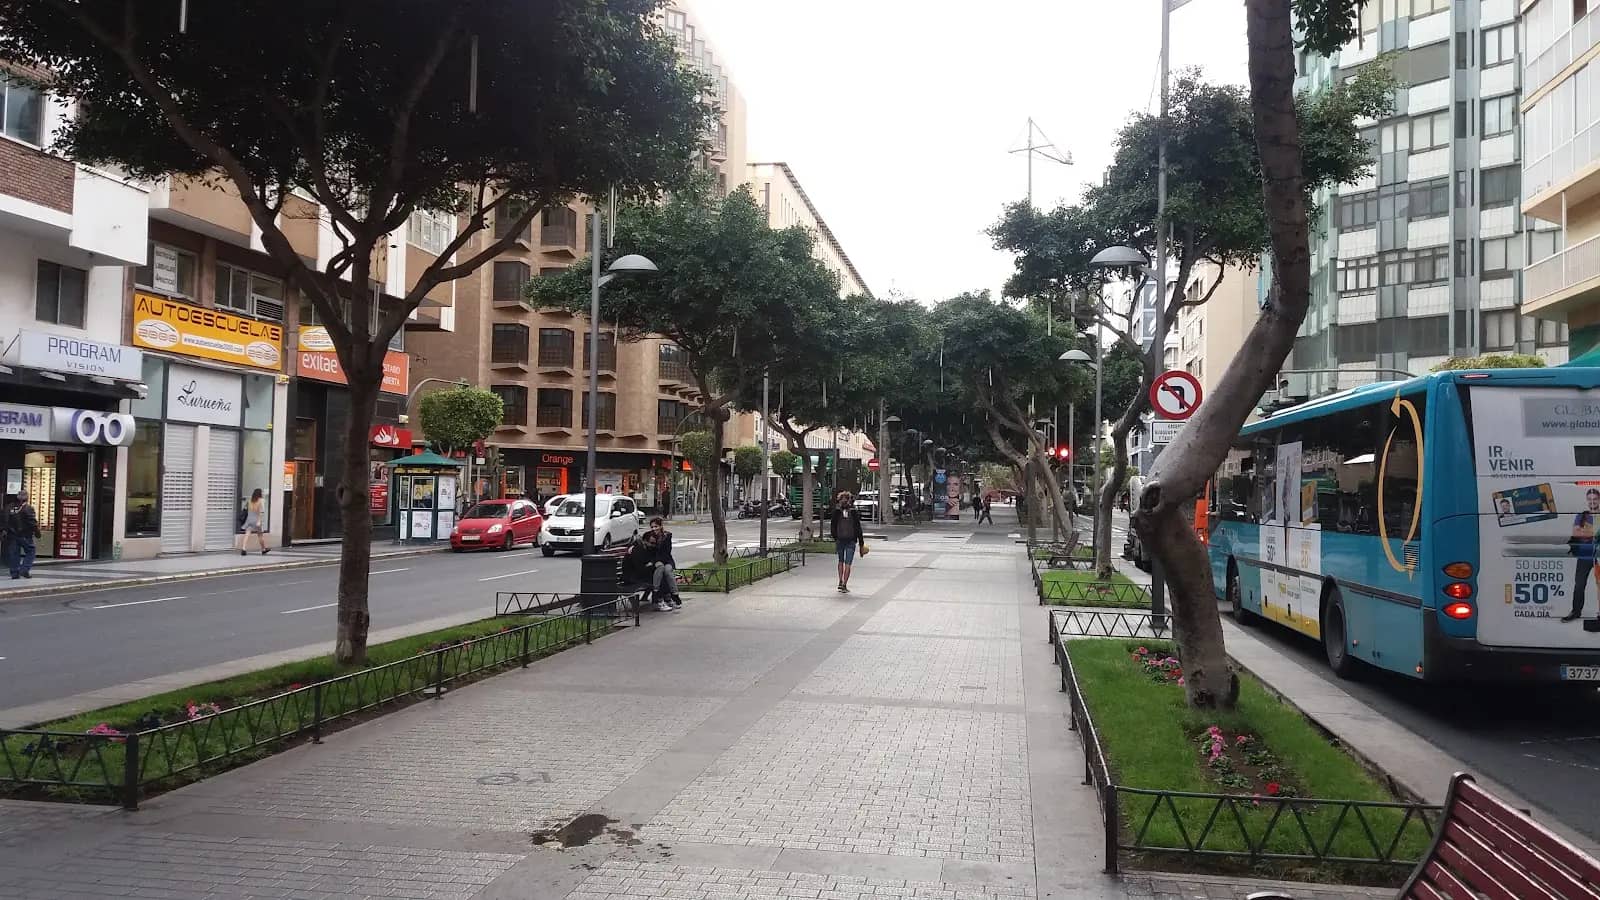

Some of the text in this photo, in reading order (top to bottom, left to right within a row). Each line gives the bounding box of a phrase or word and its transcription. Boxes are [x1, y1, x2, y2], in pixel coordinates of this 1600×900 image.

[137, 297, 280, 341] AUTOESCUELAS
[48, 336, 121, 363] PROGRAM
[66, 361, 105, 373] VISION
[302, 352, 338, 374] exitae
[1488, 445, 1504, 458] IR
[542, 453, 574, 465] Orange
[1488, 459, 1535, 471] VENIR
[1515, 560, 1564, 570] 50 USOS
[1514, 572, 1564, 582] AHORRO
[1514, 583, 1565, 604] 50%
[1514, 610, 1535, 618] CADA
[1569, 668, 1599, 679] 3737
